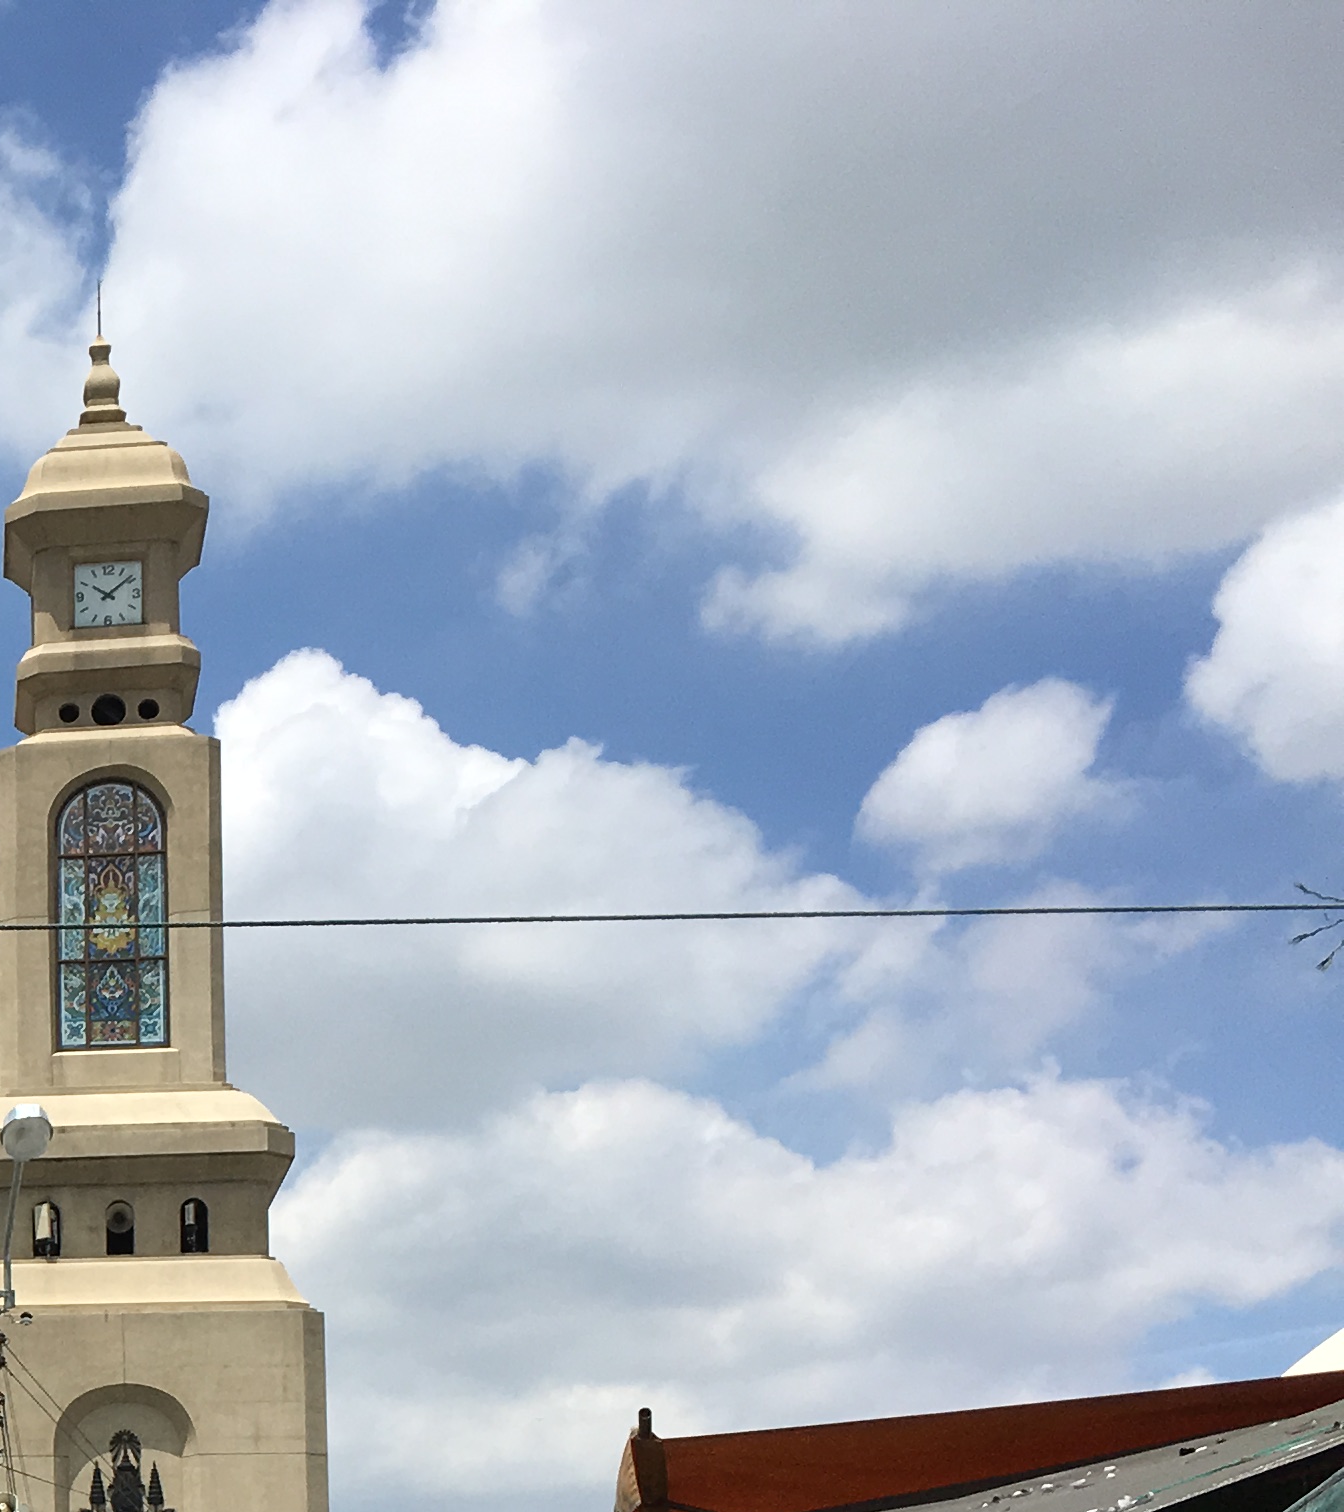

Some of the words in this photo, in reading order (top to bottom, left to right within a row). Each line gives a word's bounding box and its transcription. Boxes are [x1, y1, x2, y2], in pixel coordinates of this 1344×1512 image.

[101, 564, 115, 576] 12
[75, 591, 85, 602] 9
[132, 587, 141, 599] 3
[103, 615, 113, 626] 6
